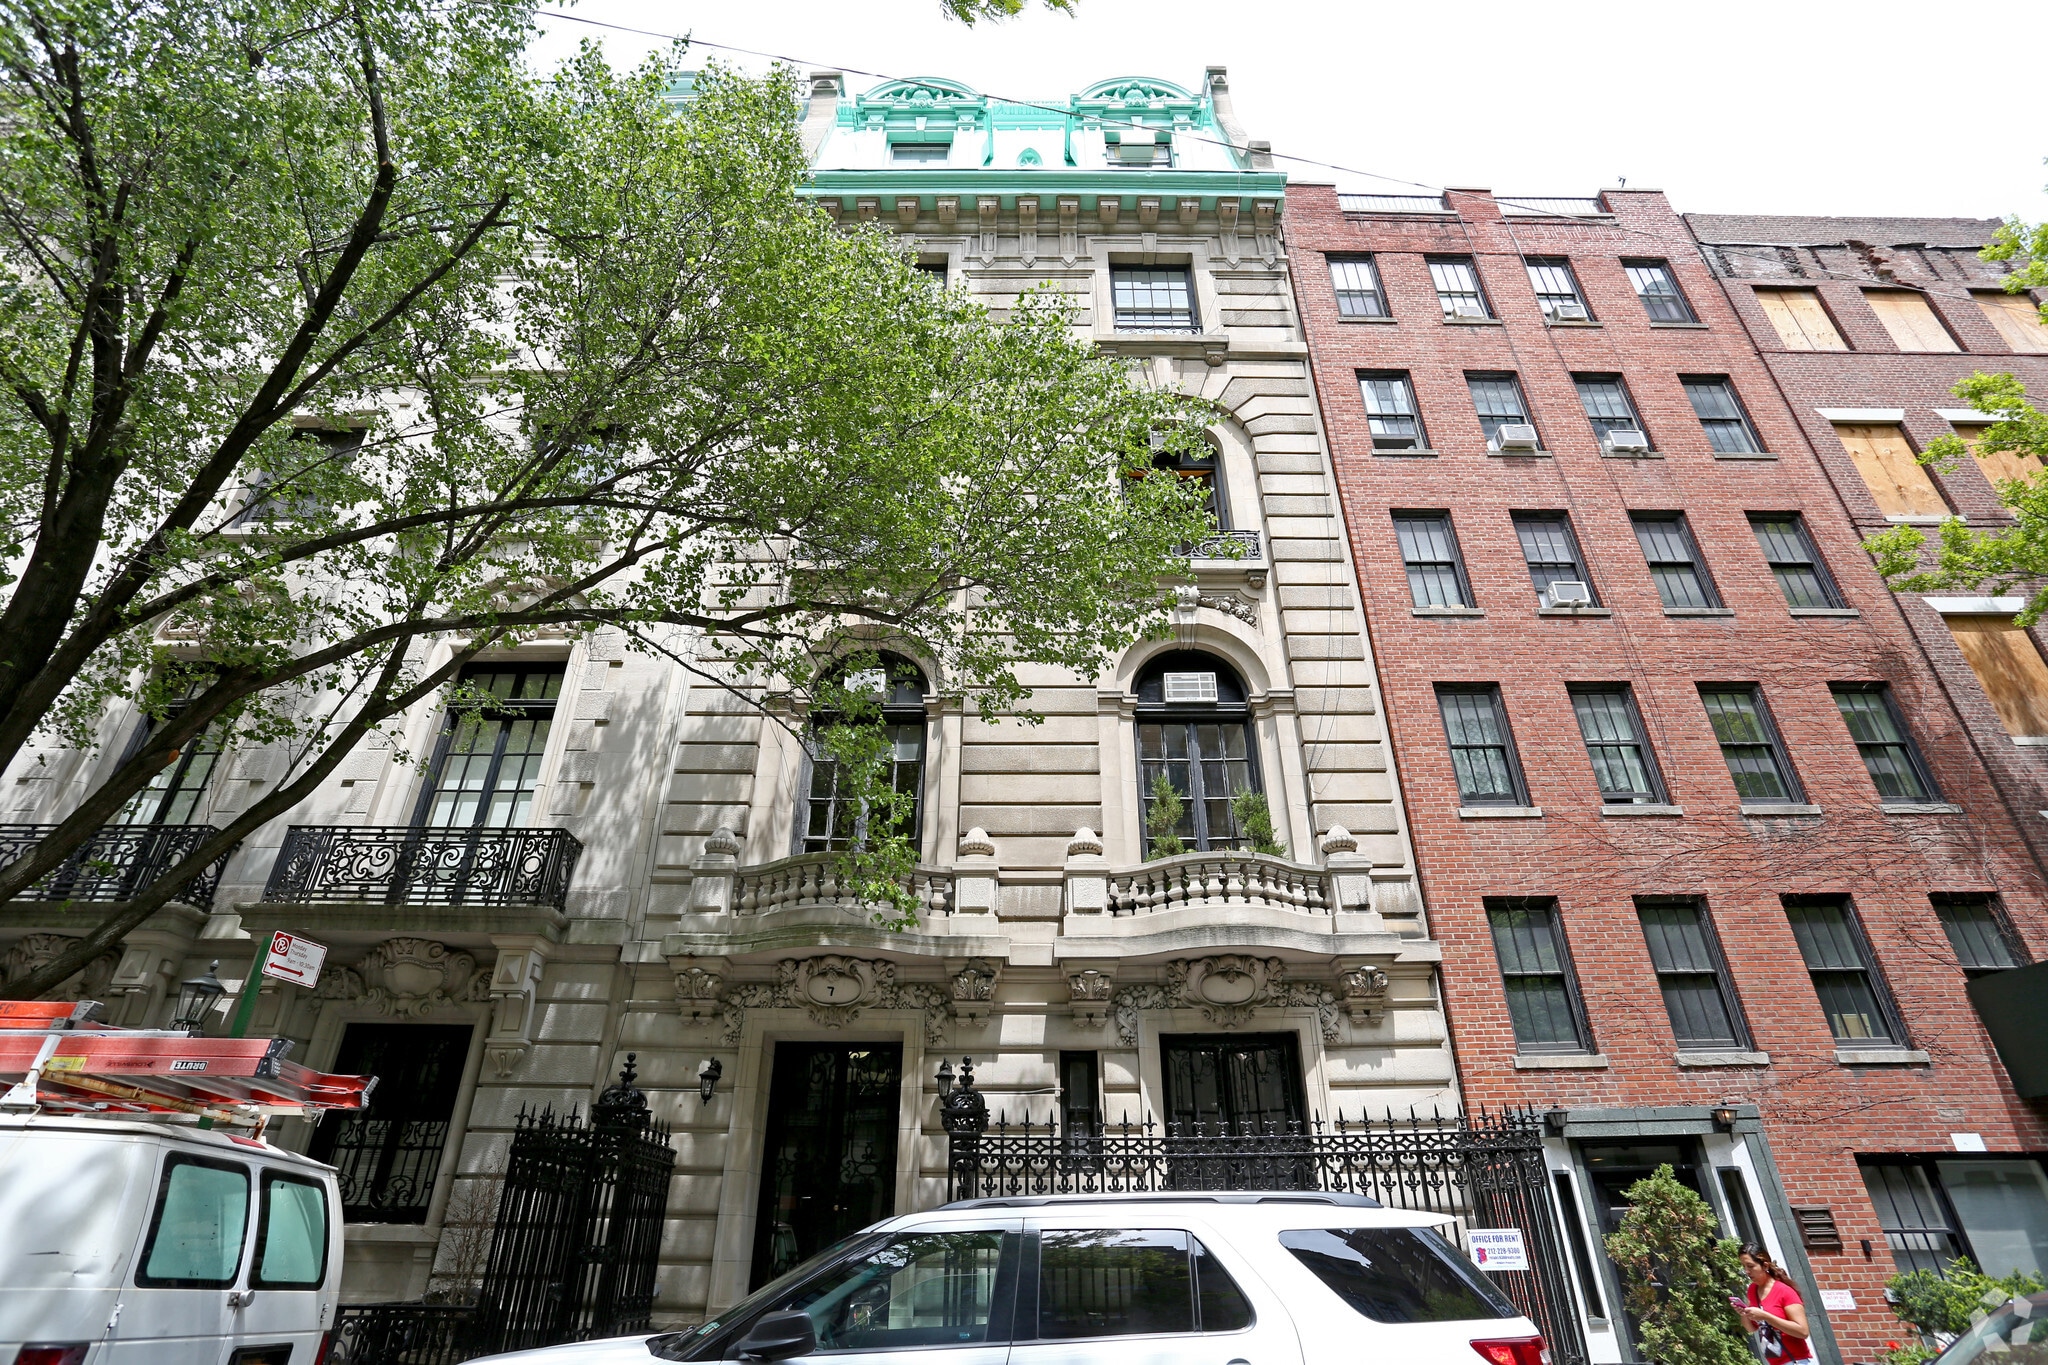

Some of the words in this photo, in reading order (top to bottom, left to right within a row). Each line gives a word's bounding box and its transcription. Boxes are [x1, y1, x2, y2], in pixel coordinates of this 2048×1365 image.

[292, 942, 308, 952] Monday
[290, 948, 308, 960] Thursday
[827, 986, 835, 996] 7
[174, 1061, 206, 1070] BRUTE
[1471, 1235, 1492, 1243] OFFICE
[1492, 1235, 1504, 1243] FOR
[1504, 1235, 1519, 1243] RENT
